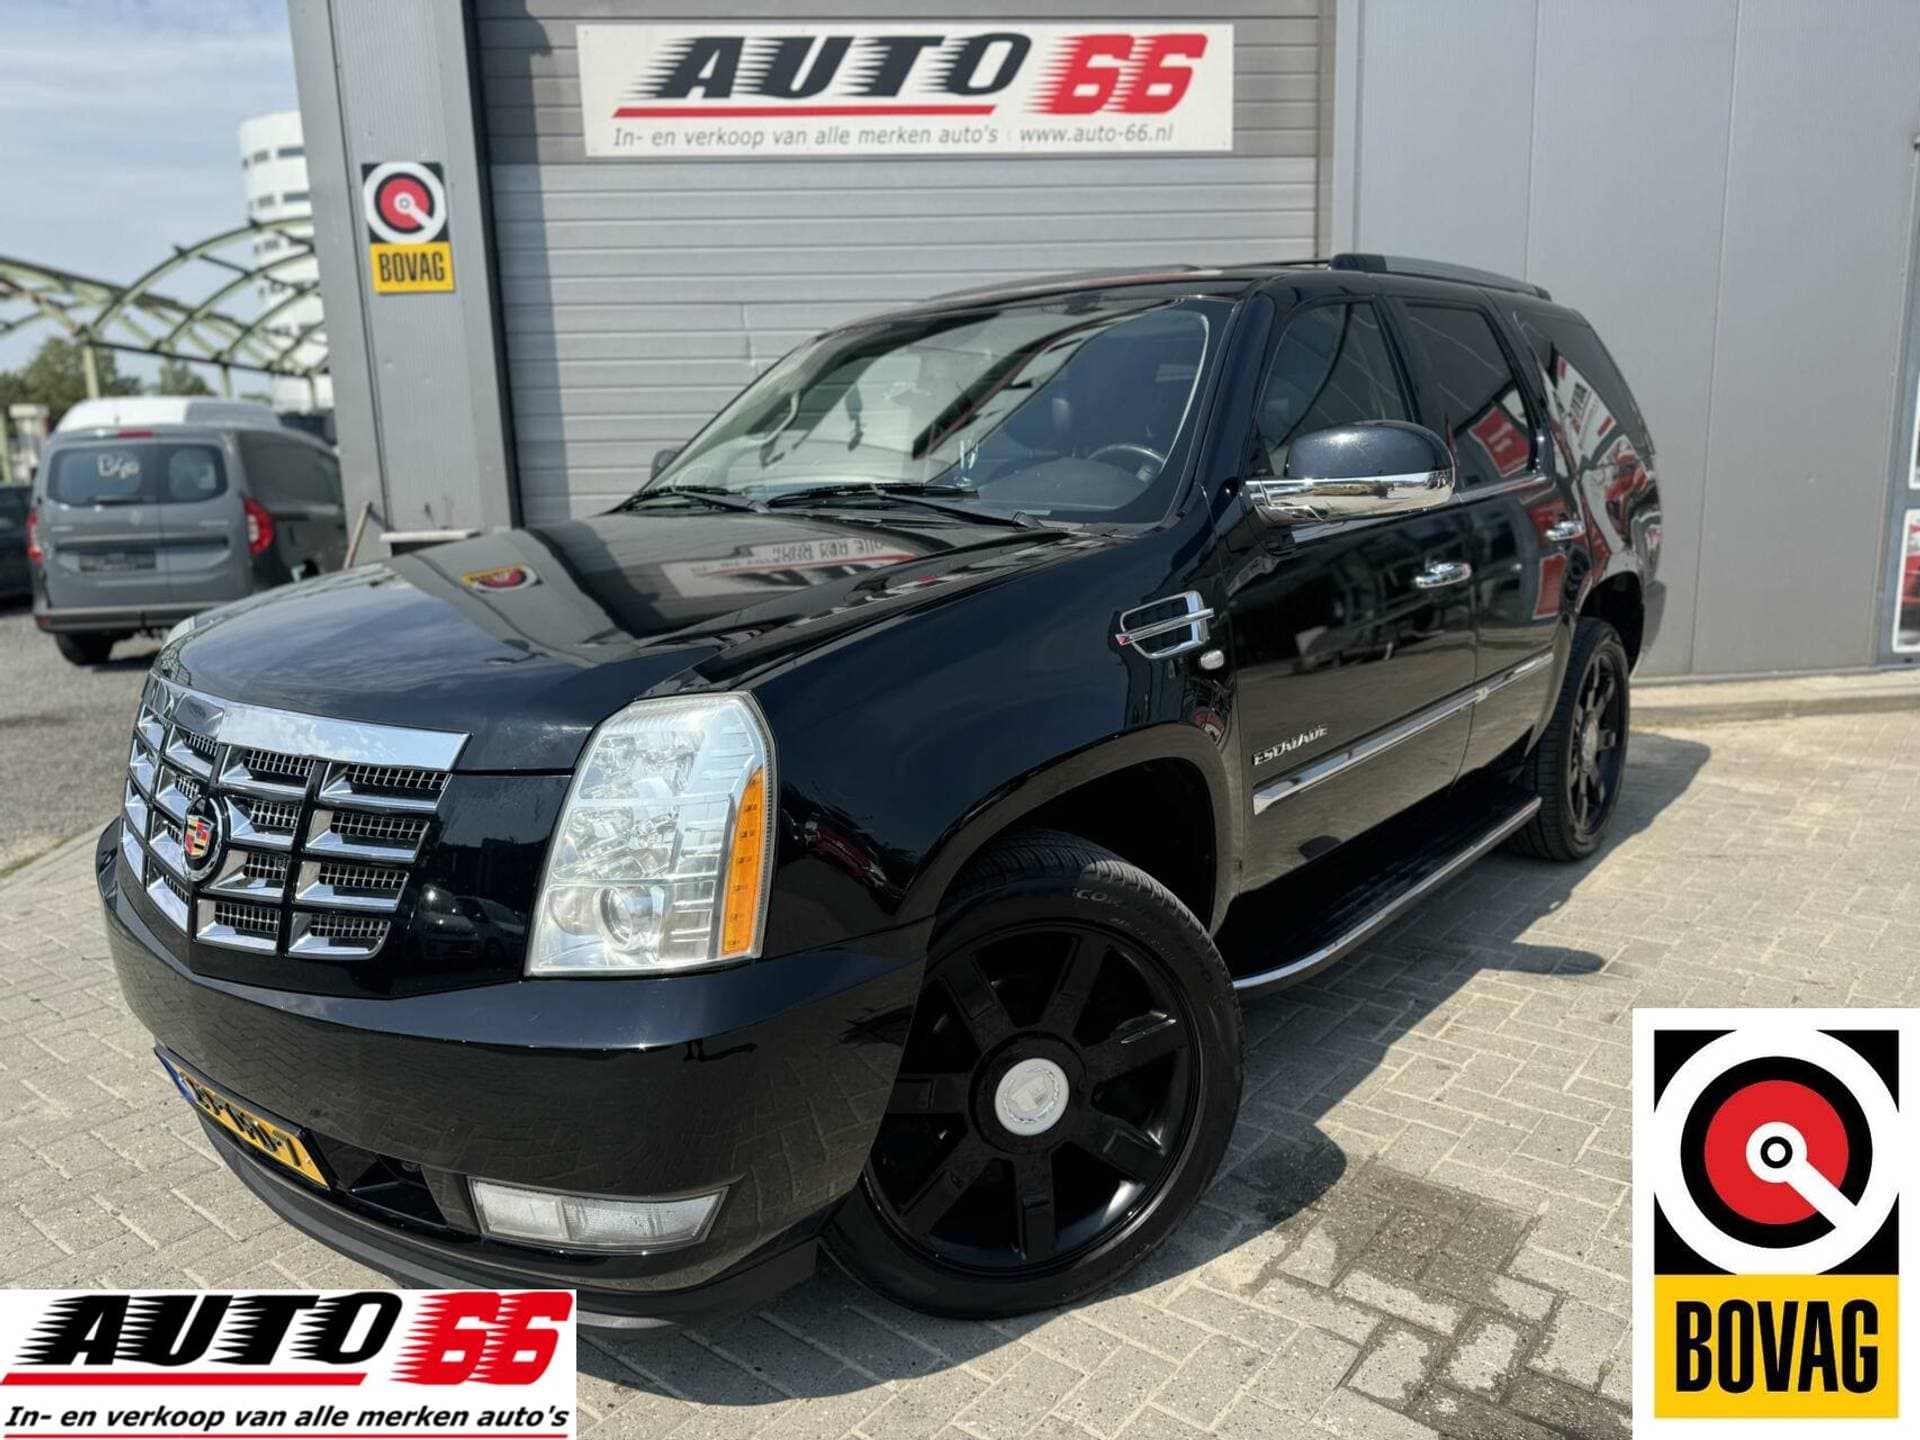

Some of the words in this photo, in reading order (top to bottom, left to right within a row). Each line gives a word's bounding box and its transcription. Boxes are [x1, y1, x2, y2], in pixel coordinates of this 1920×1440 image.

[620, 33, 1032, 101] AUTO
[1024, 33, 1209, 114] 66
[613, 127, 643, 147] In-
[651, 130, 676, 147] en
[684, 127, 764, 150] verkoop
[772, 129, 807, 145] van
[815, 126, 850, 145] alle
[858, 125, 932, 144] merken
[938, 125, 998, 144] auto's
[1019, 122, 1174, 143] www.auto-66.nl
[378, 252, 445, 283] BOVAG
